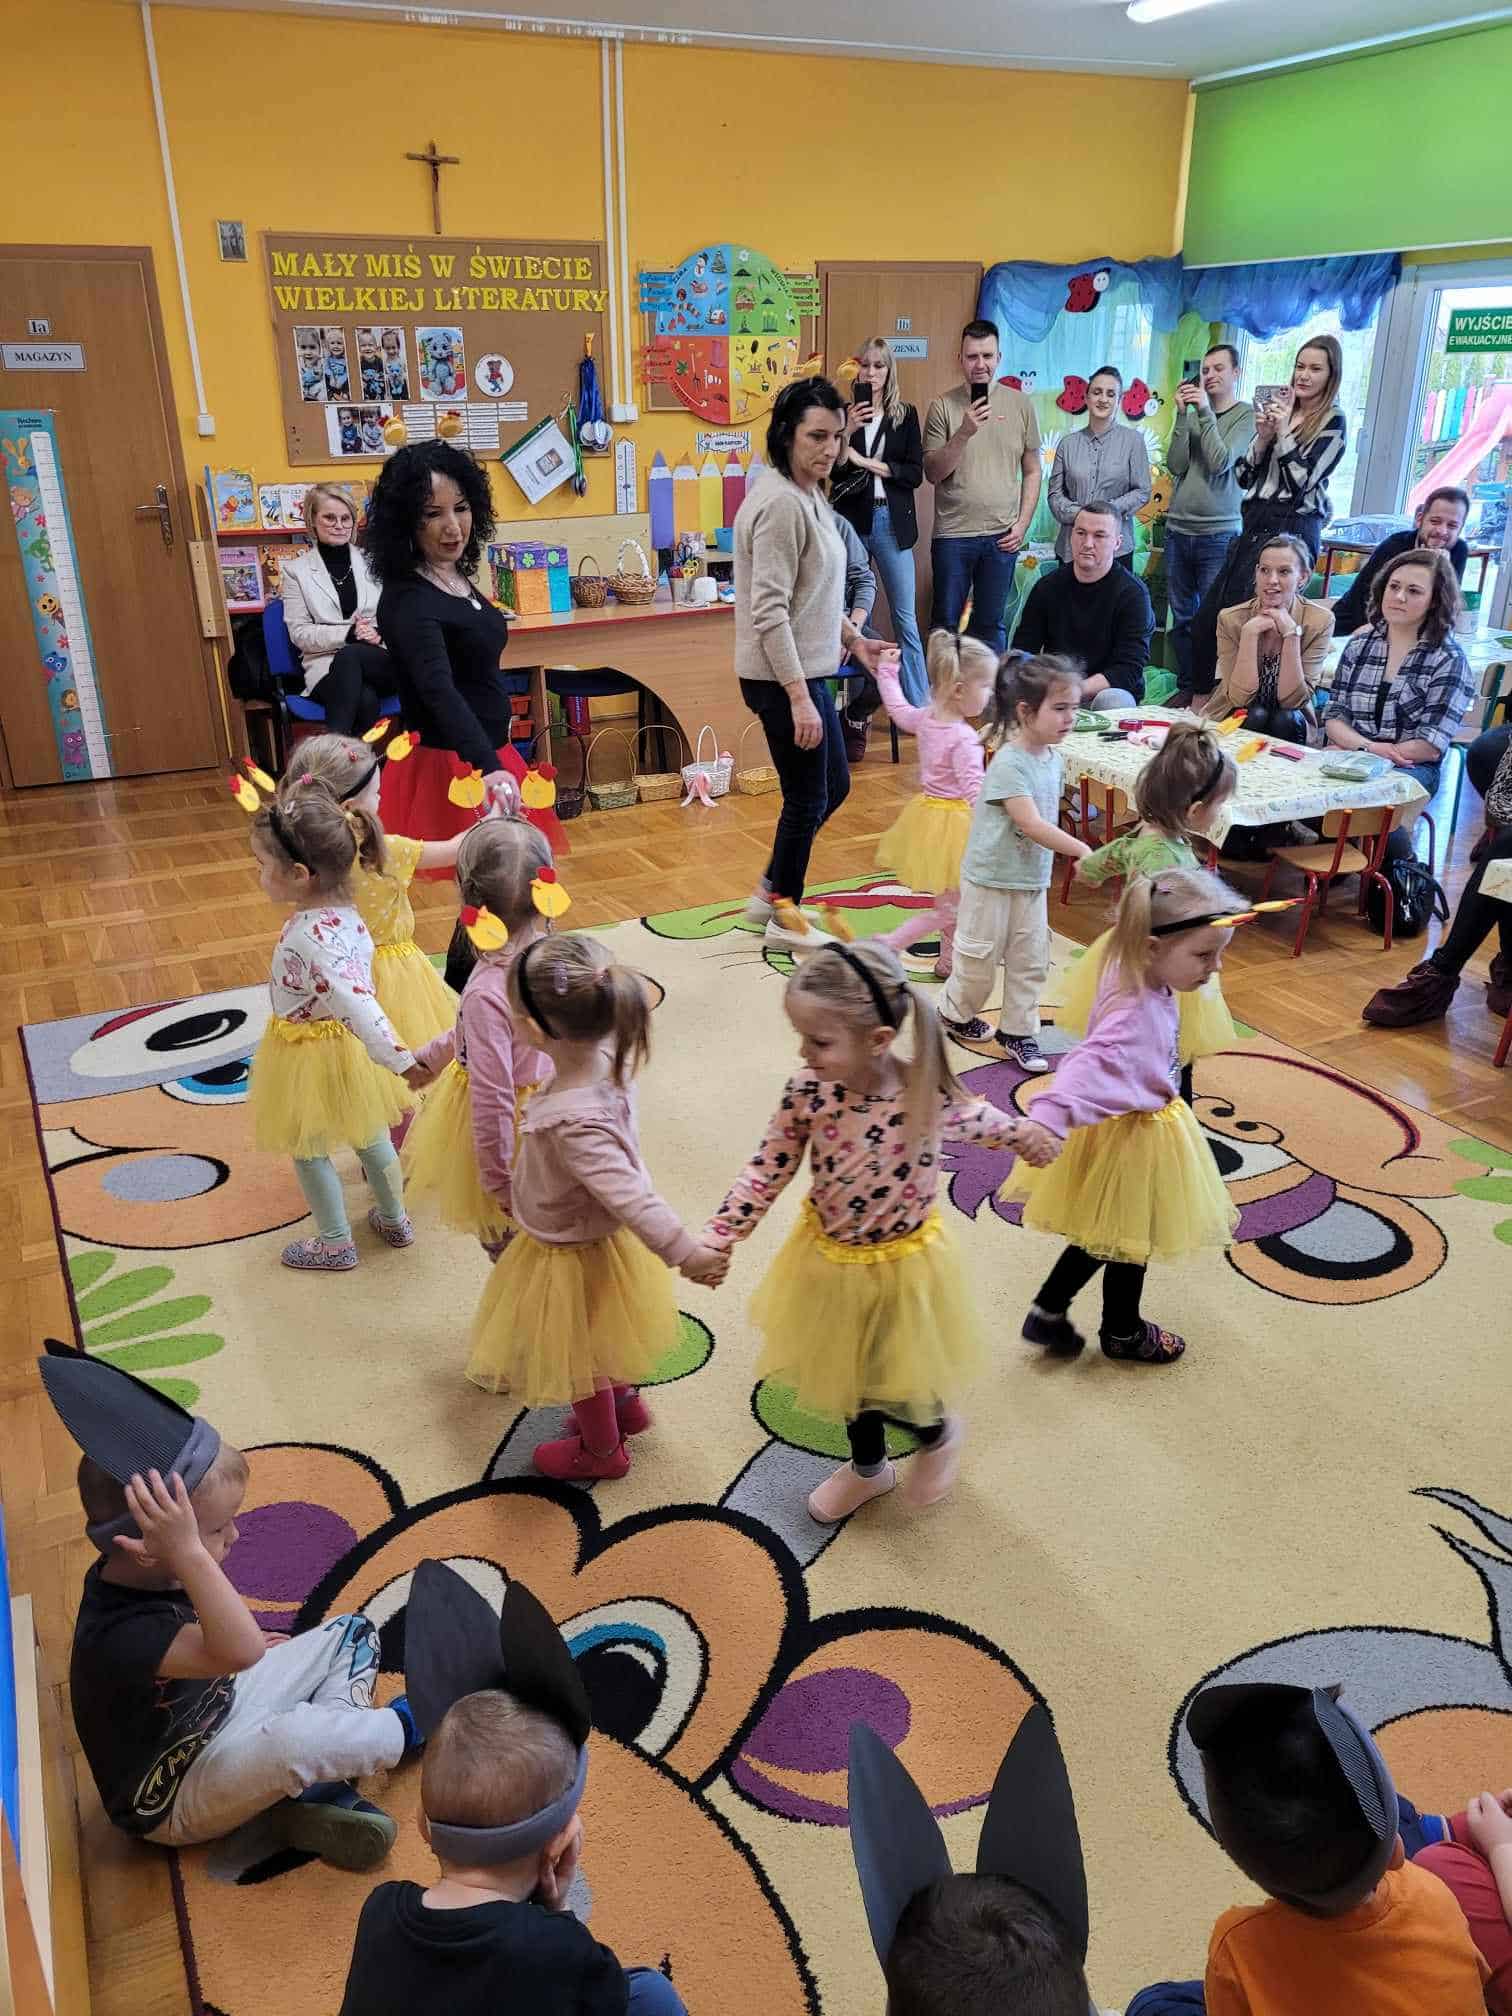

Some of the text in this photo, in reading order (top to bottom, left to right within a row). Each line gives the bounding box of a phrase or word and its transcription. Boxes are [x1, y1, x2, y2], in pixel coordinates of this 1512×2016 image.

[271, 242, 593, 281] MAŁY MIŚ W ŚWIECIE
[272, 285, 609, 312] WIELKIEJ LITERATURY
[1455, 312, 1512, 331] WYJŚCIE
[1448, 334, 1512, 346] EWAKUACYJNE
[893, 343, 921, 353] ZIENKA
[15, 351, 73, 362] MAGAZYN
